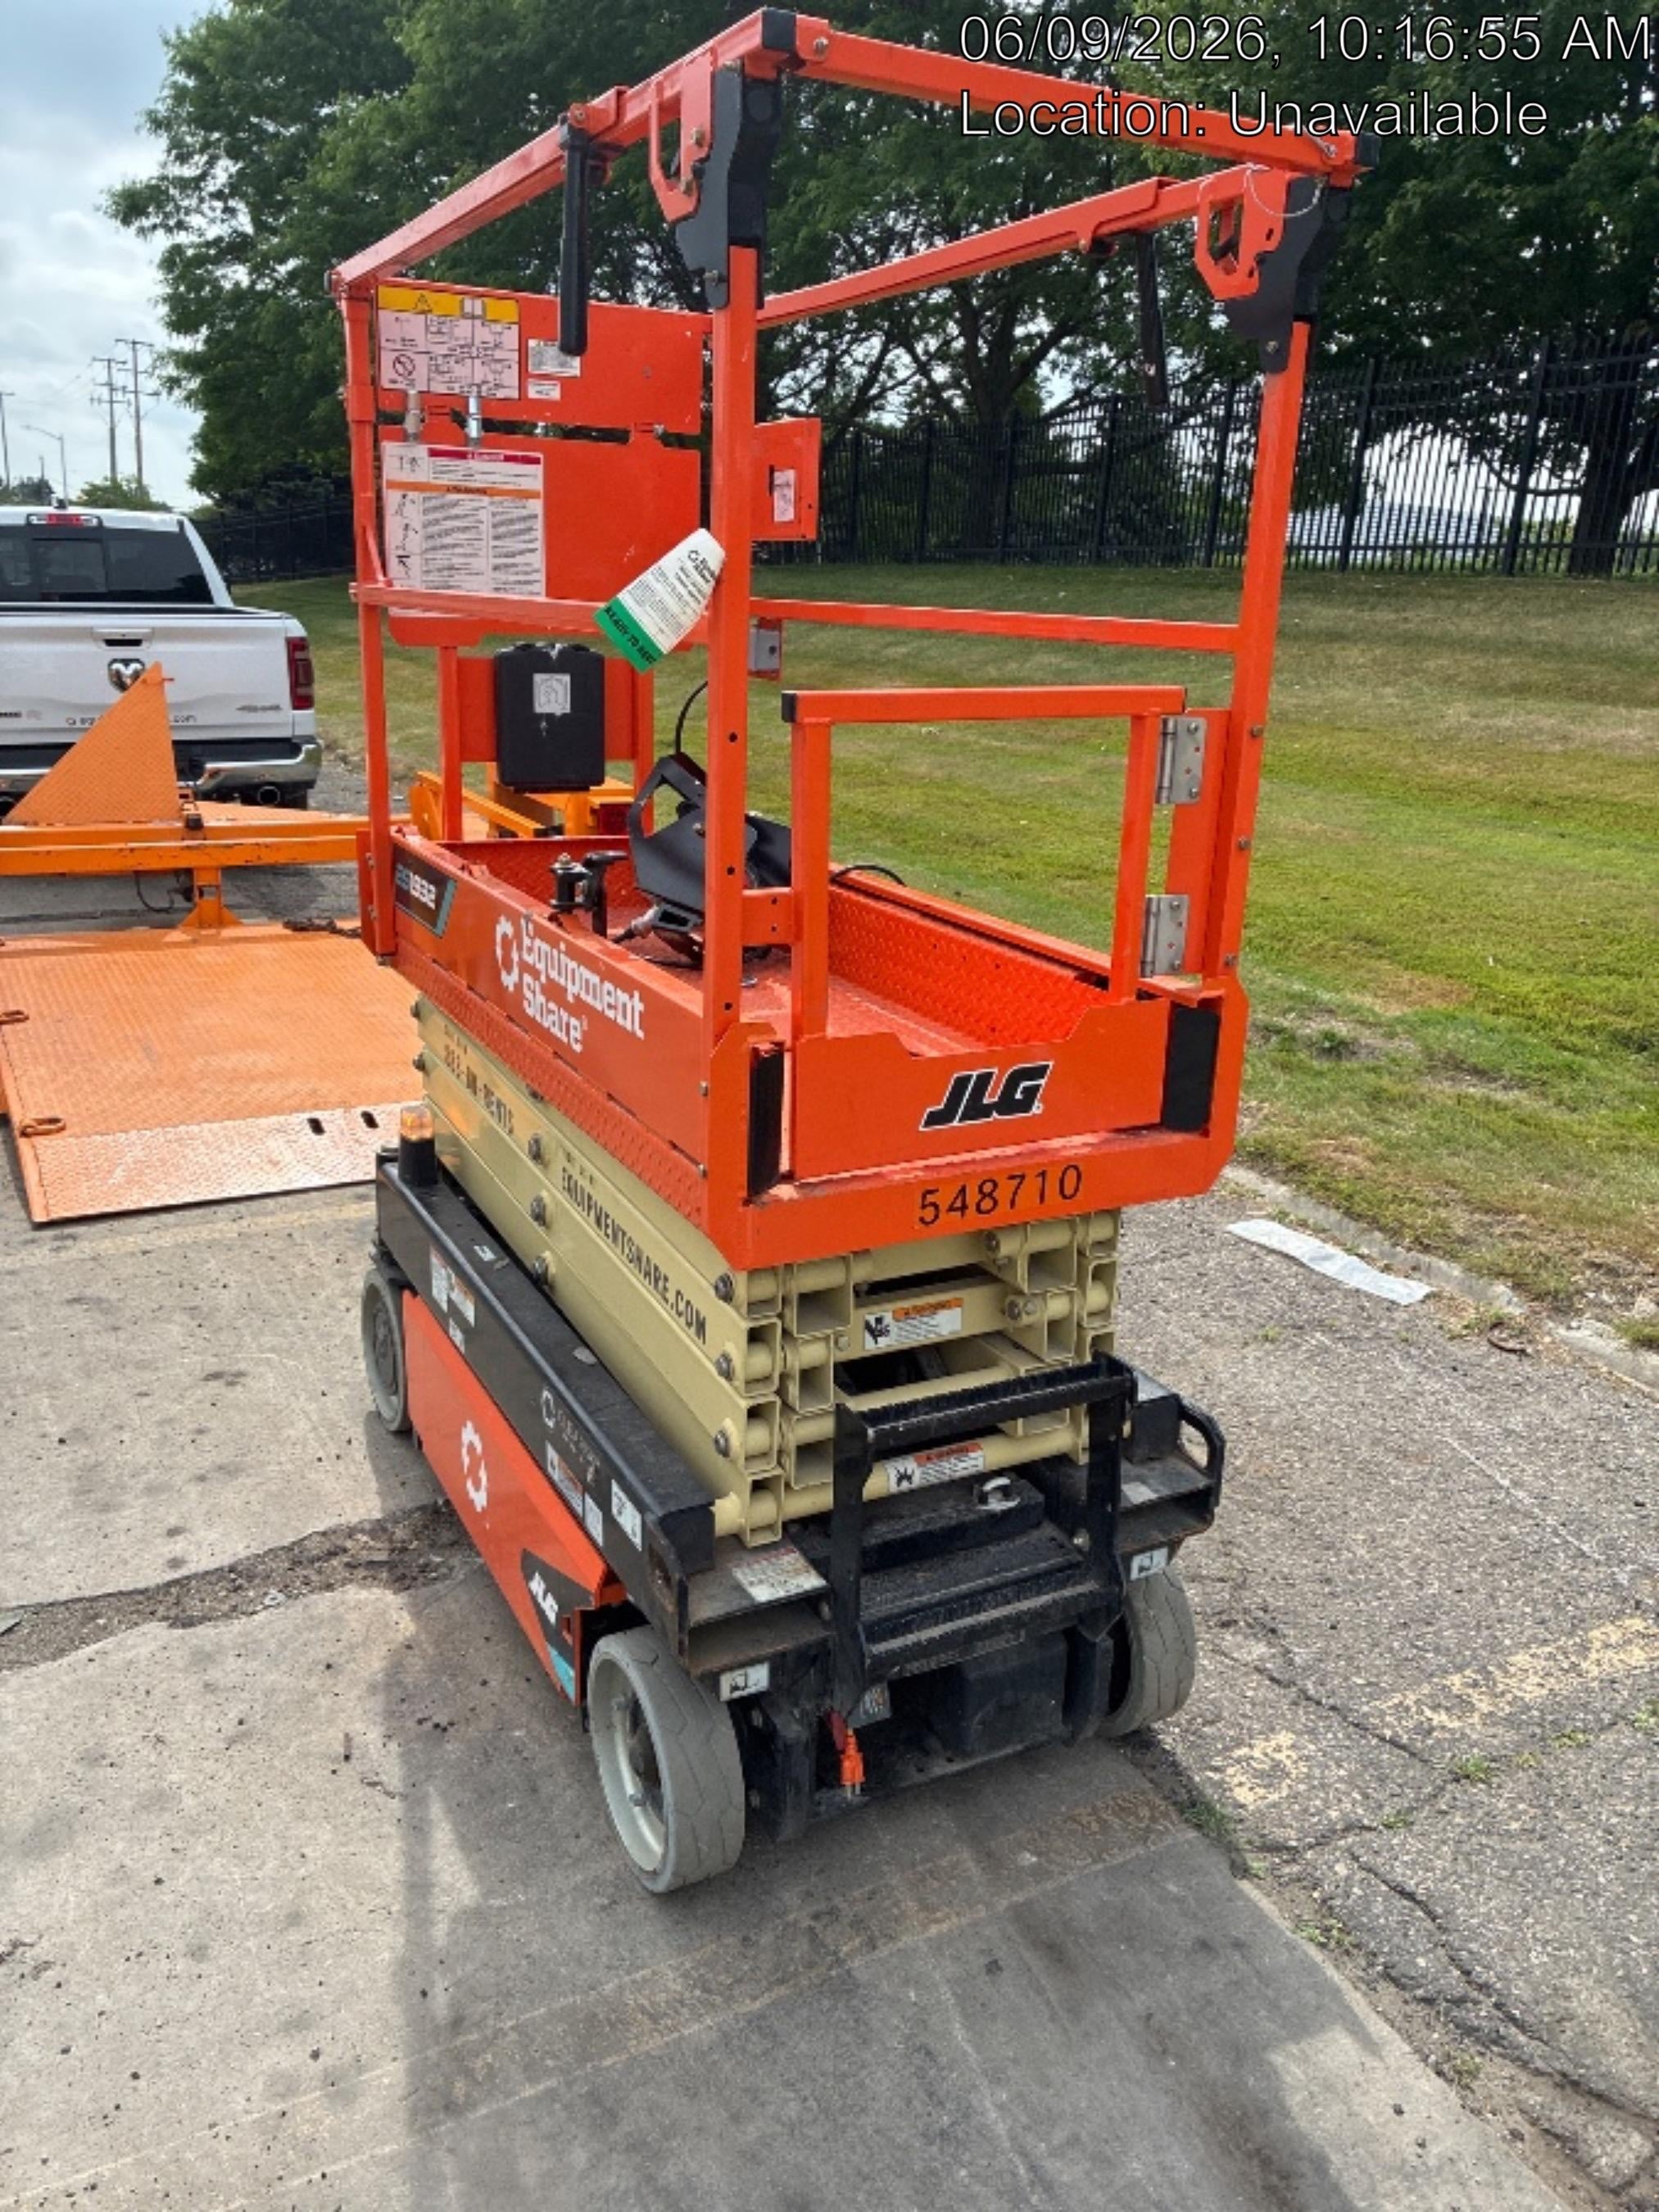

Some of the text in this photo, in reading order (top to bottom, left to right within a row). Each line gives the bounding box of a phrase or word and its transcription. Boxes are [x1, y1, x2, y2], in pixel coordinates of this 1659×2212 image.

[520, 915, 645, 1040] Equipment
[523, 972, 583, 1054] Share
[918, 1061, 1054, 1131] JLG
[918, 1163, 1083, 1226] 548710
[561, 1165, 707, 1346] EQUIPMENTSHARE.COM
[528, 1571, 560, 1626] JLG
